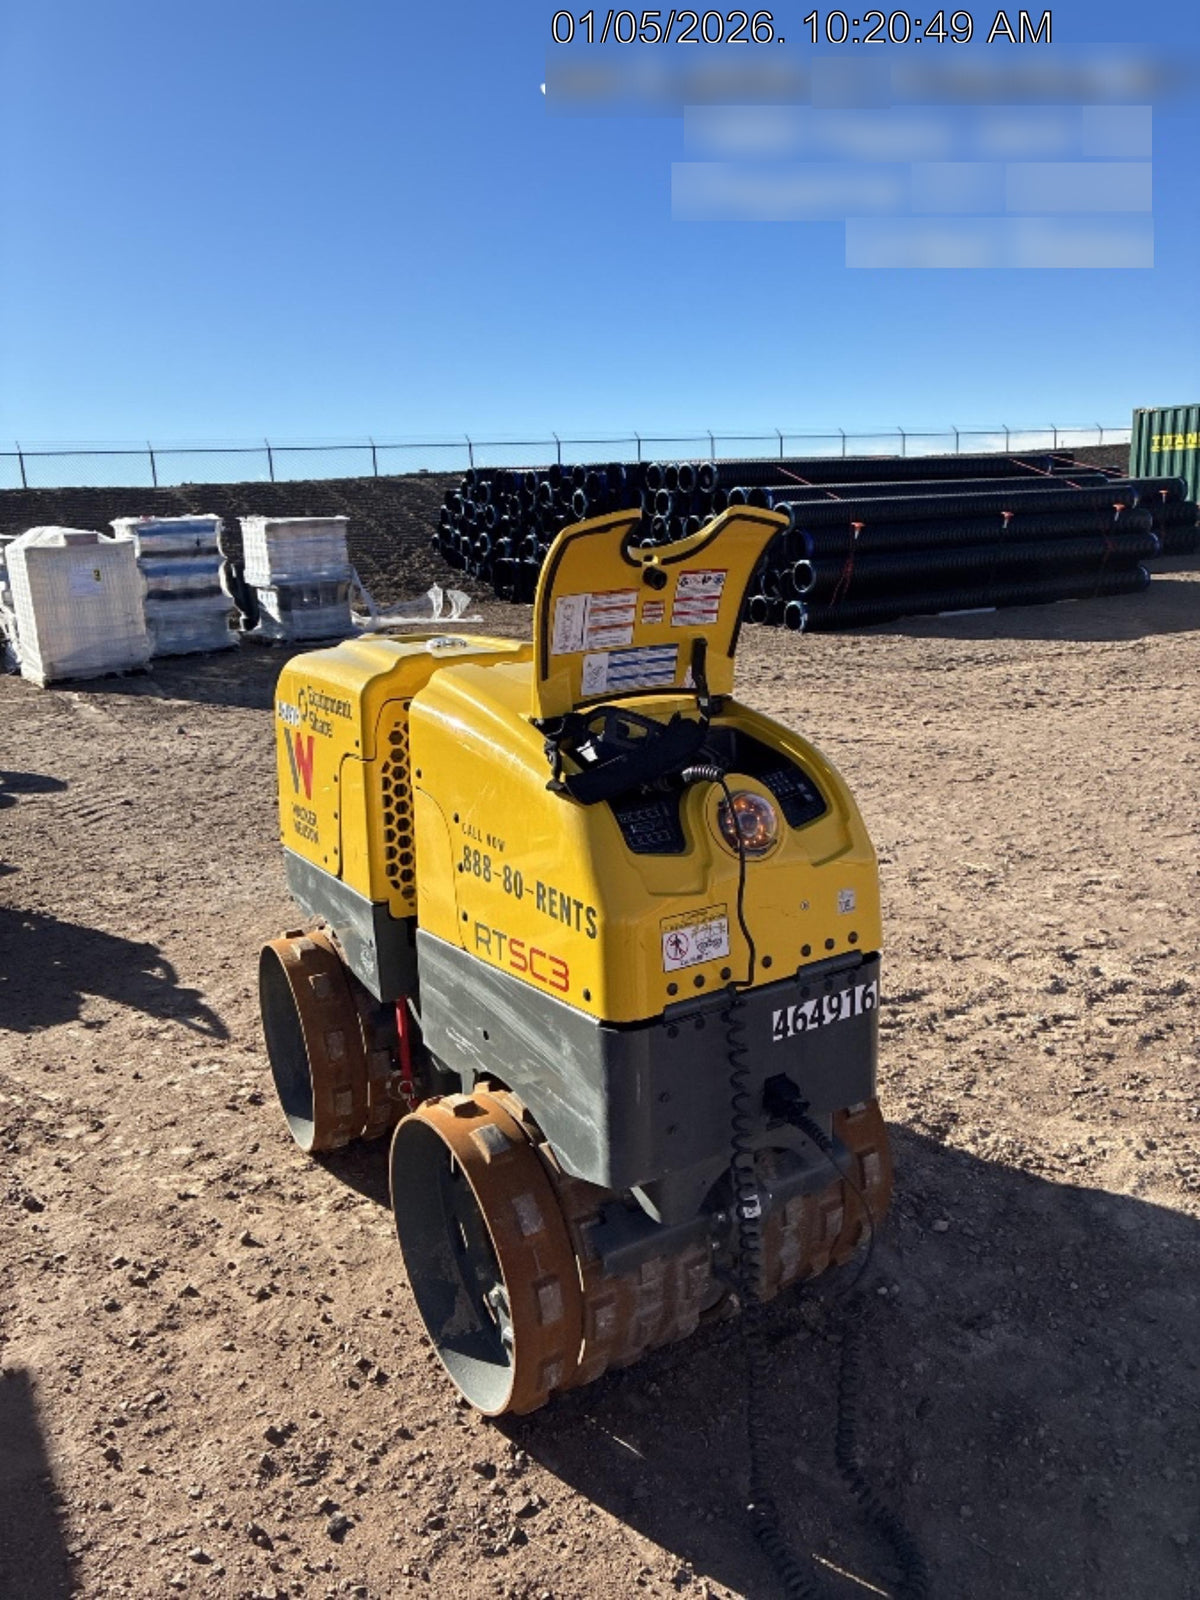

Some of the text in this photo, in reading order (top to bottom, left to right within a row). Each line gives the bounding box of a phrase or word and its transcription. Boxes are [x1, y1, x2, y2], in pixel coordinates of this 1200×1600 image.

[1151, 431, 1200, 449] TITAN
[462, 822, 506, 852] CALL NOW
[463, 845, 598, 939] 888-80-RENTS
[474, 920, 570, 993] RTSC3
[773, 979, 877, 1041] 464916
